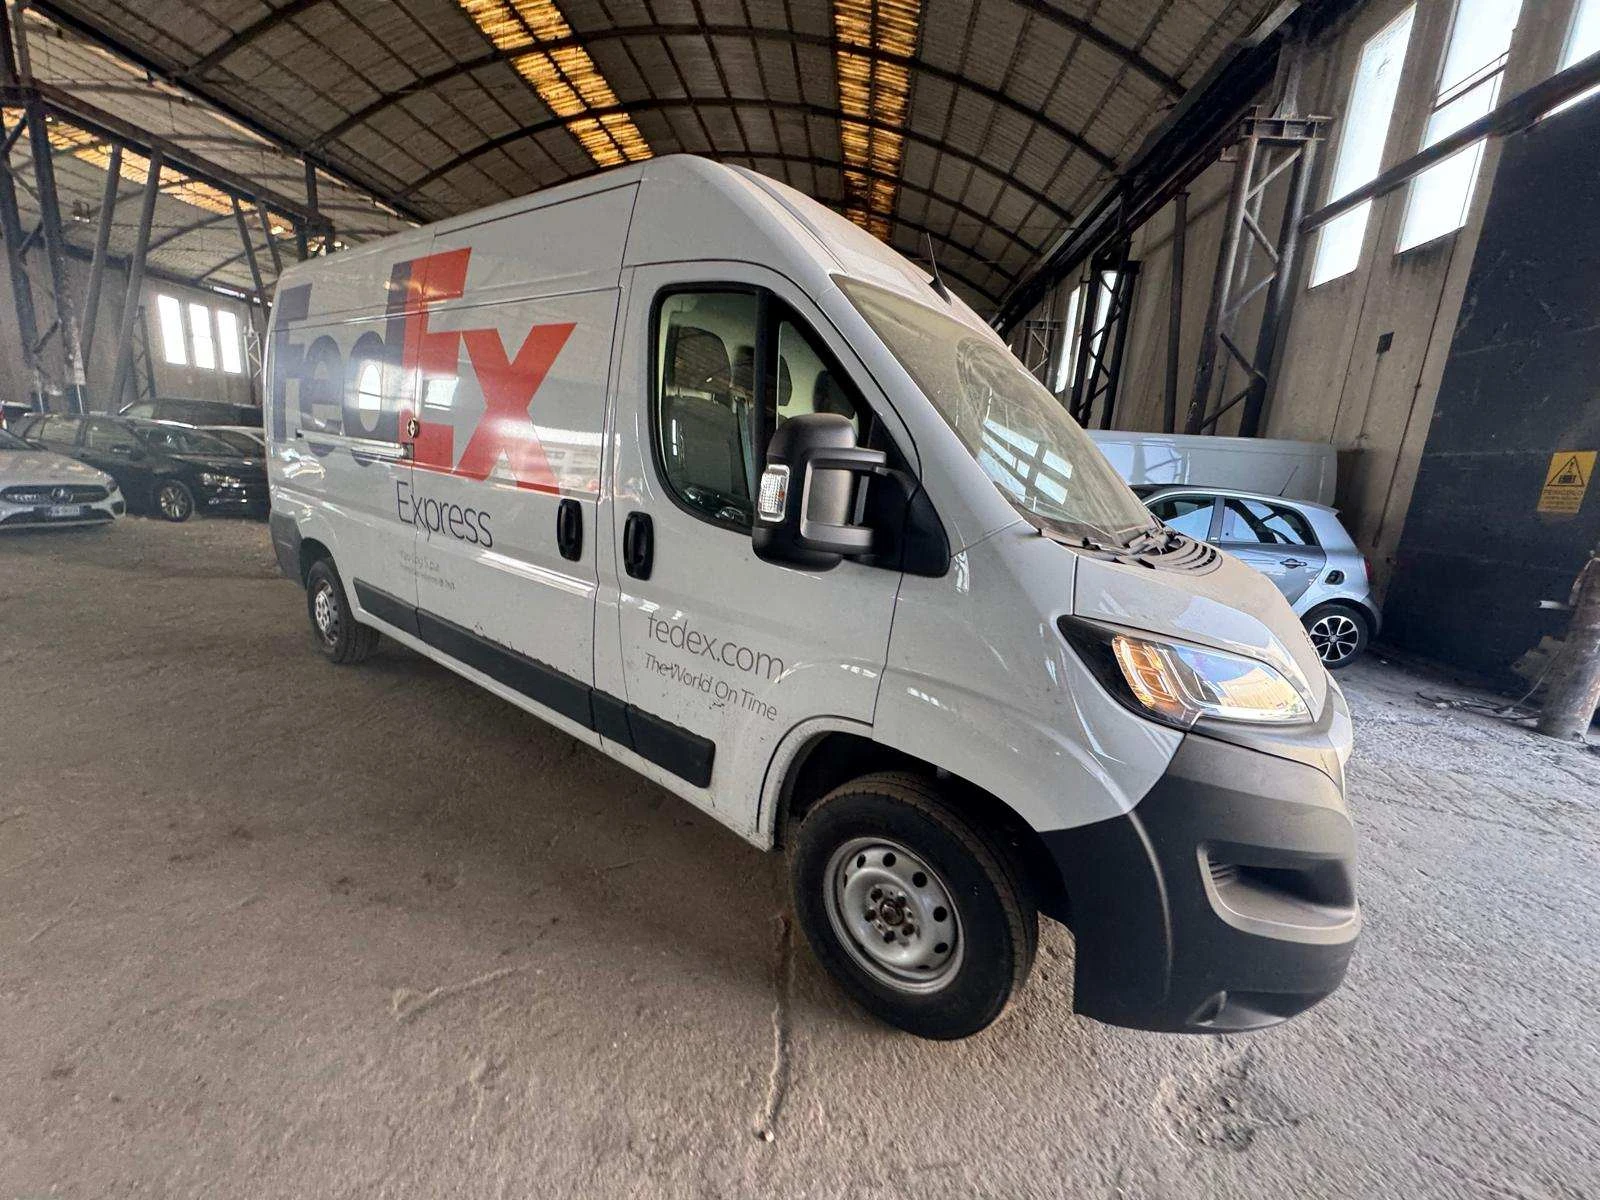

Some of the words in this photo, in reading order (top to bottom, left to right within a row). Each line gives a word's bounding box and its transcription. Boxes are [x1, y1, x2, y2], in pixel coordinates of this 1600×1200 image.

[272, 247, 578, 495] FedEx
[396, 480, 493, 548] Express
[647, 611, 785, 684] fedex.com
[645, 652, 667, 677] The
[670, 663, 713, 693] World
[715, 680, 738, 704] On
[741, 688, 777, 721] Time
